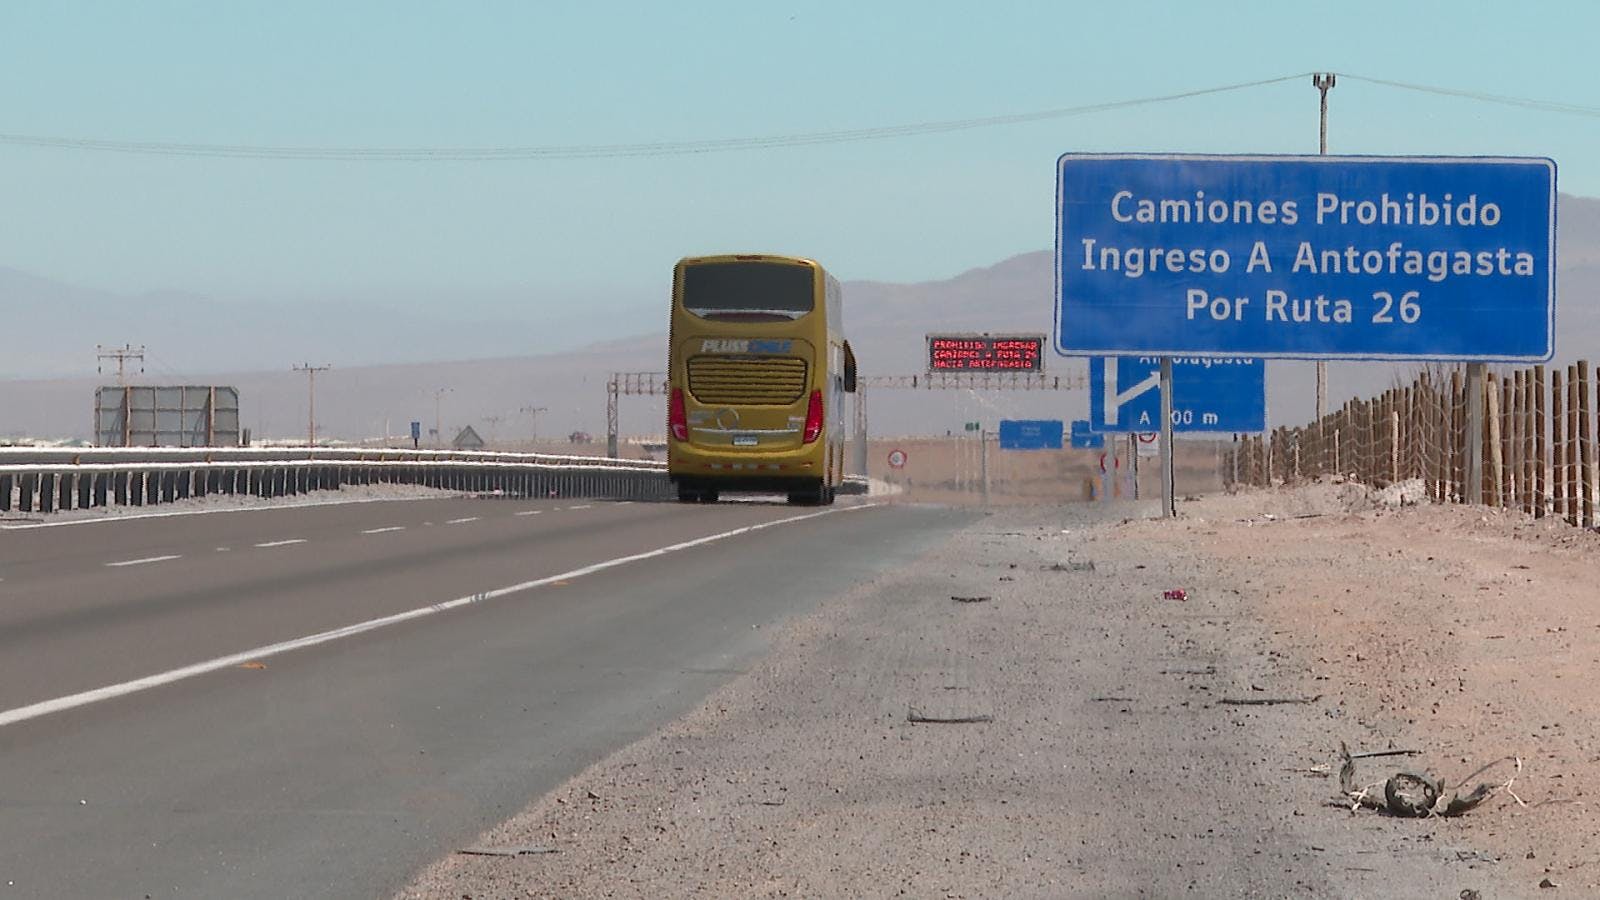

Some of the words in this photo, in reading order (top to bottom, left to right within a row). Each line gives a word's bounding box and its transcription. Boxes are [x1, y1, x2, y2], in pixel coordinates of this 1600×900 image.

[1111, 190, 1299, 225] Camiones
[1316, 192, 1501, 227] Prohibido
[1081, 238, 1230, 279] Ingreso
[1246, 241, 1272, 273] A
[1293, 241, 1535, 283] Antofagasta
[1186, 289, 1249, 321] Por
[1265, 290, 1353, 324] Ruta
[1372, 292, 1421, 324] 26
[1139, 410, 1151, 425] A
[1170, 410, 1193, 425] 00
[1203, 412, 1218, 425] m
